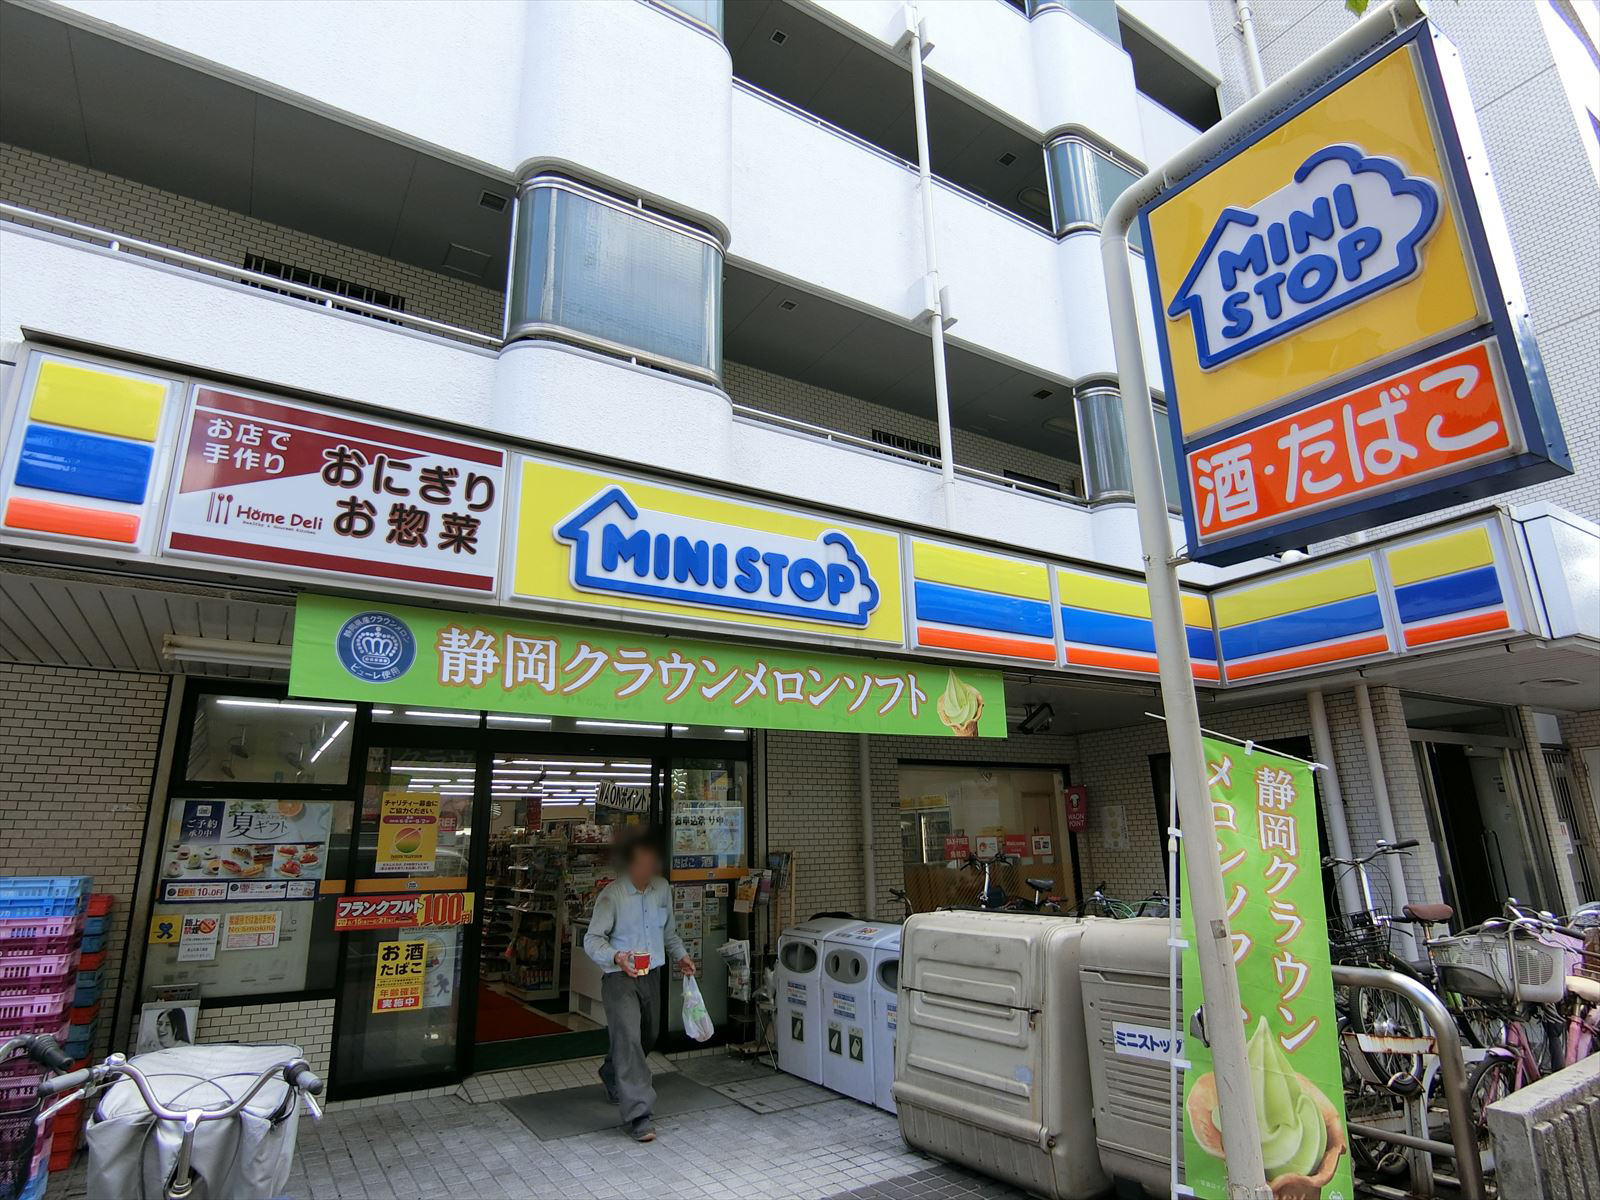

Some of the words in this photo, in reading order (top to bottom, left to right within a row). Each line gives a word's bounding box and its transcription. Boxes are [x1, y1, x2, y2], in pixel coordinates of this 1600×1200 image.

[1217, 183, 1359, 292] MINI
[1221, 225, 1383, 339] STOP
[202, 443, 287, 475] 手作り
[206, 417, 293, 450] お店で
[1197, 363, 1500, 529] 酒・たばこ
[321, 445, 496, 512] おにぎり
[236, 505, 286, 525] Home
[290, 513, 324, 531] Deli
[334, 496, 482, 556] お惣菜
[601, 523, 856, 606] MINISTOP
[436, 625, 929, 718] 静岡クラウンメロンソフト
[185, 818, 218, 830] ご予約
[338, 898, 424, 918] フランクフルト
[1255, 766, 1317, 1051] 静岡クラウン
[380, 962, 422, 976] たばこ
[381, 997, 415, 1009] 実施中
